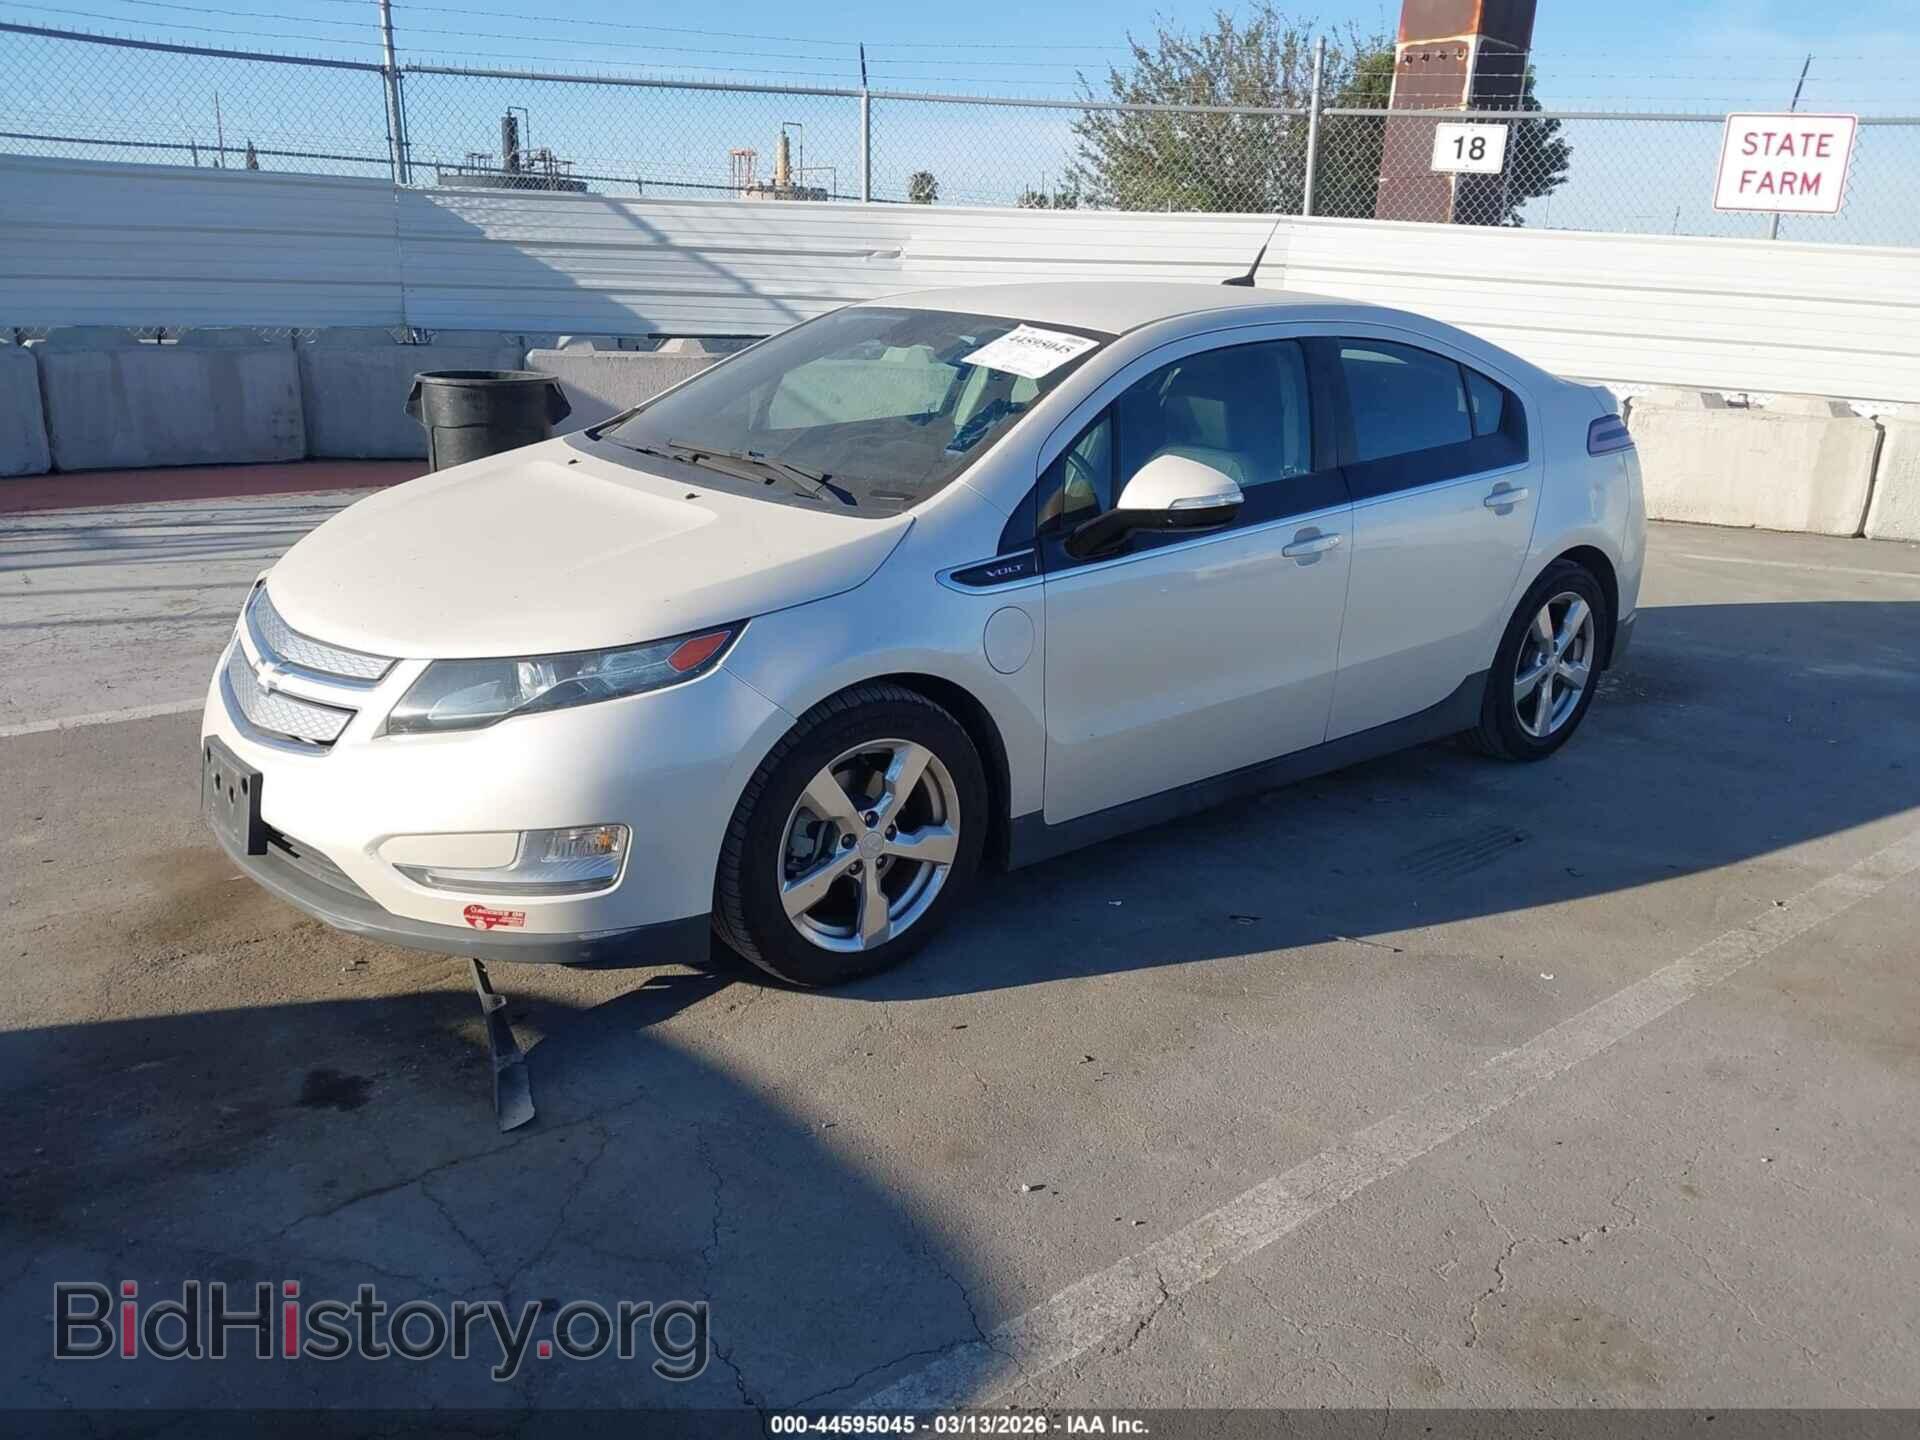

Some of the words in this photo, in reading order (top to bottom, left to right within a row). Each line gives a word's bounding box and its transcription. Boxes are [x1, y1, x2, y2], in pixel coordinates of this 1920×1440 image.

[1452, 136, 1486, 161] 18
[1741, 132, 1835, 158] STATE
[1739, 171, 1822, 196] FARM
[986, 565, 1023, 577] VOLT
